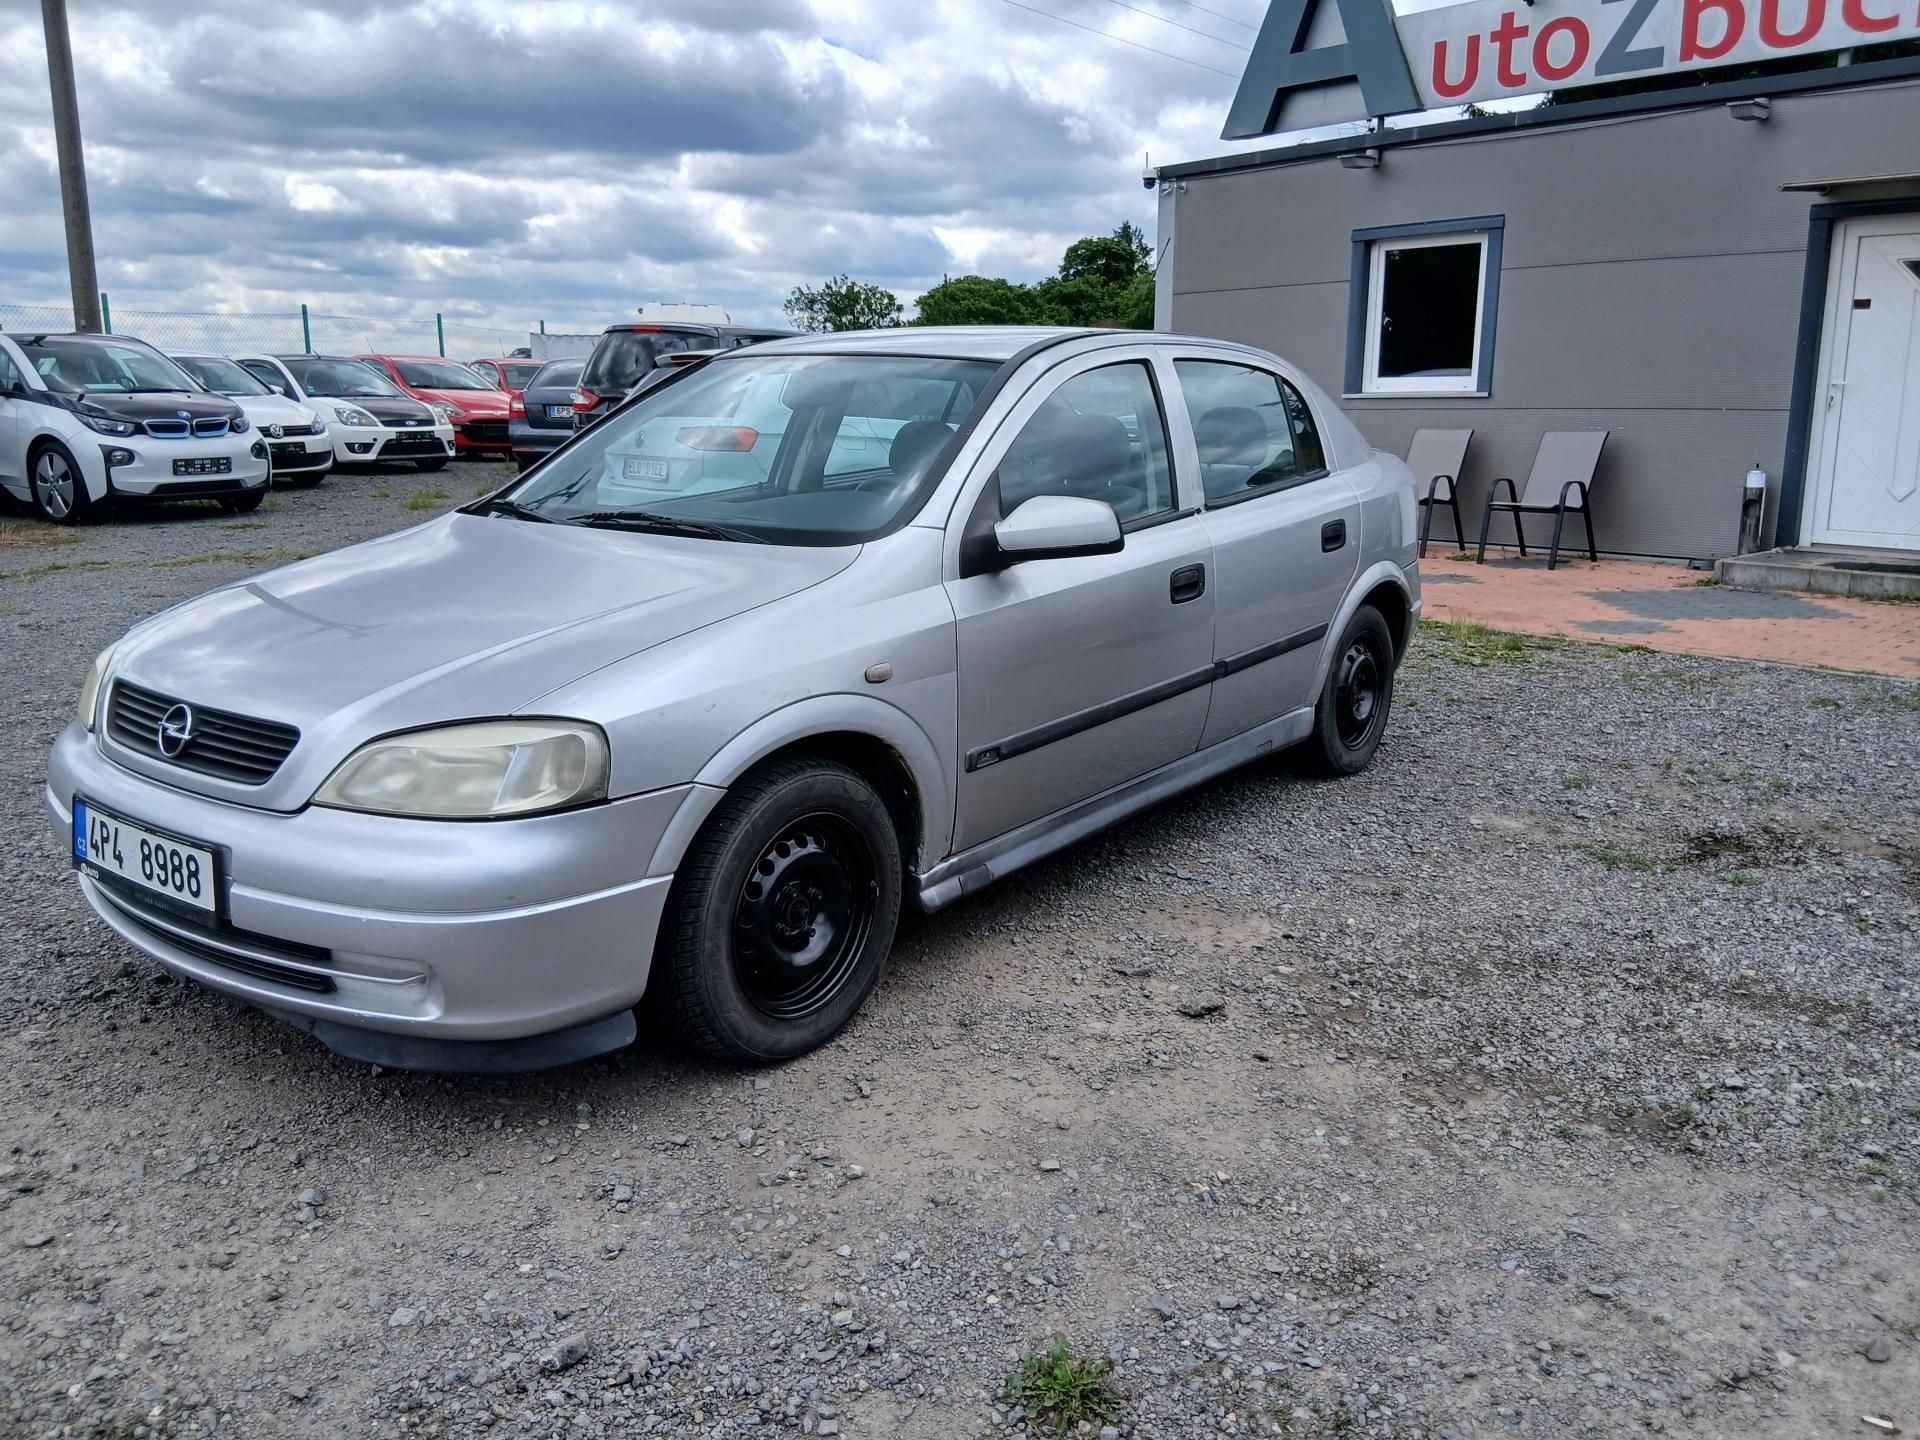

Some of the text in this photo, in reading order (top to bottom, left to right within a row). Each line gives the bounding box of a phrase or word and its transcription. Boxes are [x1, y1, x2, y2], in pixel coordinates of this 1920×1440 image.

[1220, 0, 1920, 140] AutoZbuc
[90, 816, 201, 898] 4P4 8988
